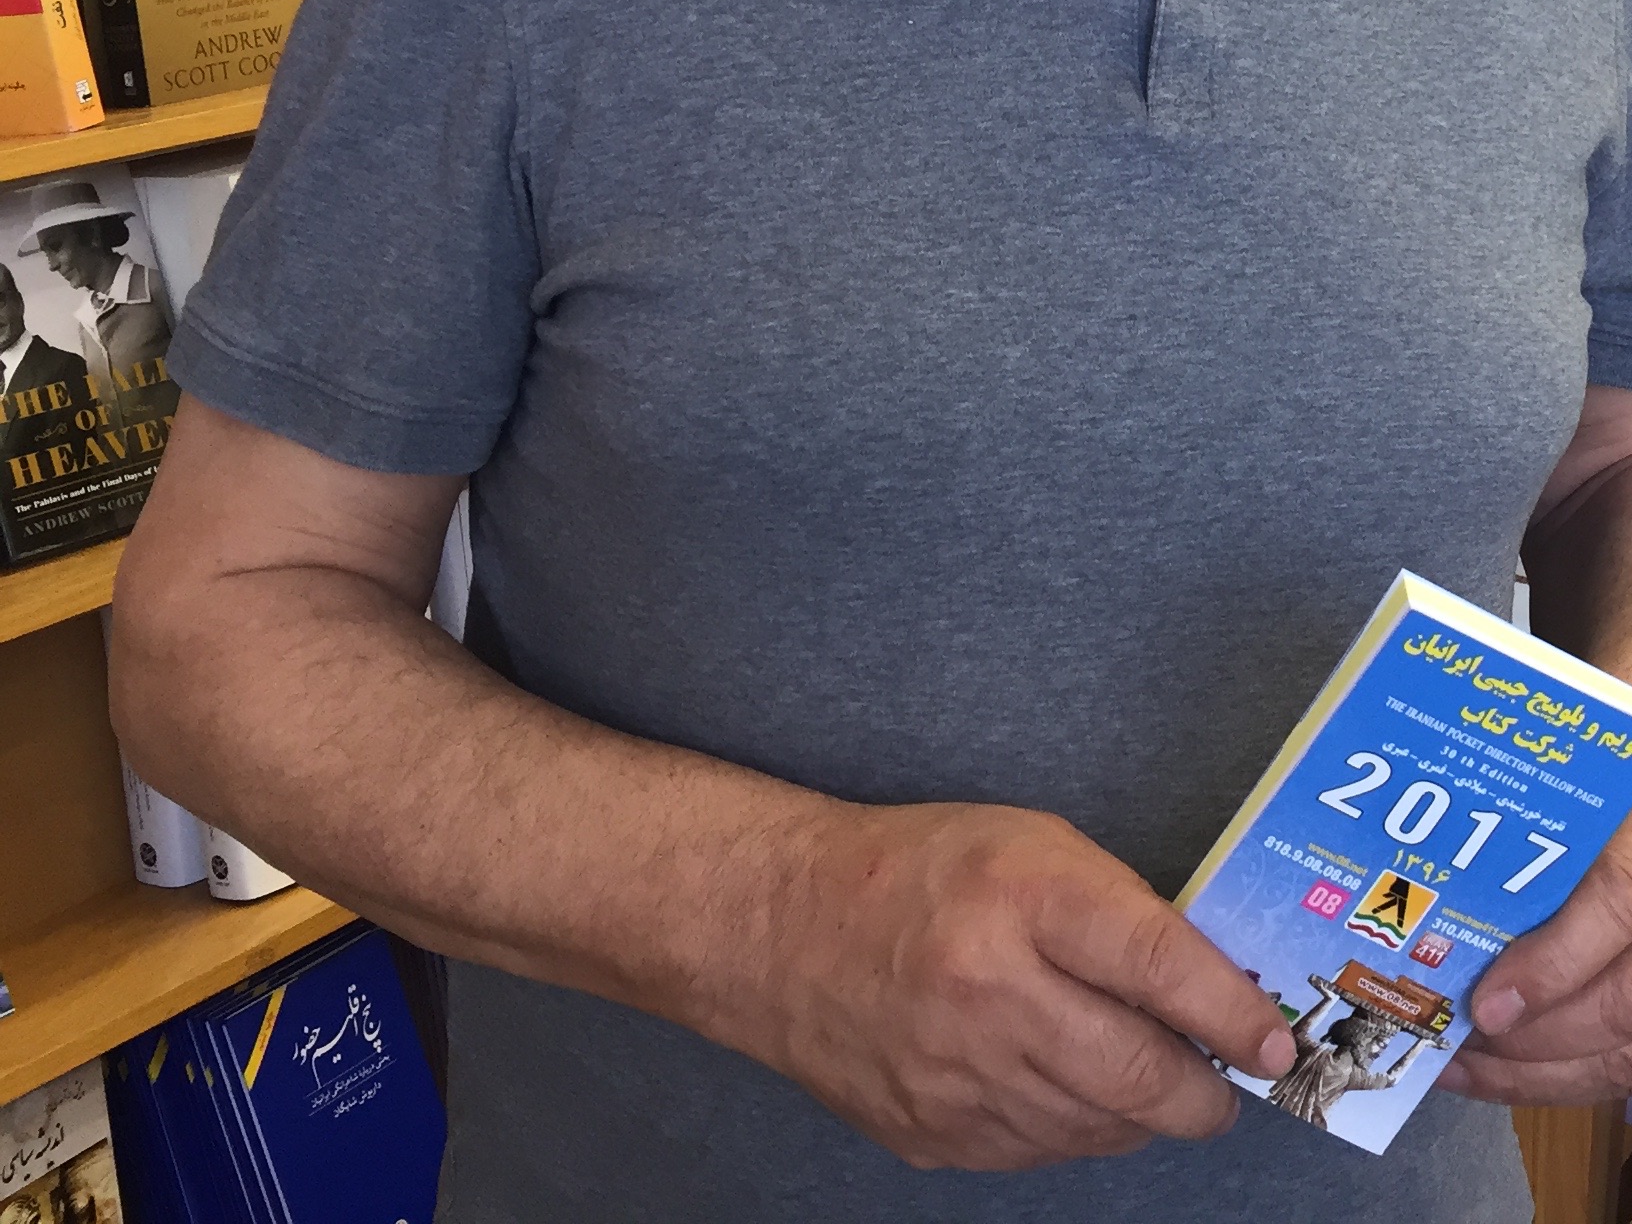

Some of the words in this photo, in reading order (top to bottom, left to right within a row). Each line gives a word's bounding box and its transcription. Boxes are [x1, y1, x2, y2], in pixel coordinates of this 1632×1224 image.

[175, 2, 212, 19] Changed
[224, 11, 252, 26] Middle
[252, 8, 271, 22] East
[193, 23, 283, 60] ANDREW
[162, 59, 231, 93] SCOTT
[74, 403, 114, 432] OF
[15, 501, 32, 514] The
[34, 493, 69, 509] Pahlavis
[69, 487, 86, 499] and
[86, 482, 101, 494] the
[101, 477, 123, 489] Final
[123, 470, 143, 484] Days
[143, 466, 153, 477] of
[22, 507, 93, 538] ANDREW
[97, 490, 146, 513] SCOTT
[1403, 633, 1485, 678] ایرانیان
[1471, 672, 1530, 704] جیبی
[1459, 705, 1519, 736] کتاب
[1579, 722, 1600, 742] و
[1385, 695, 1408, 714] THE
[1404, 703, 1448, 735] IRANIAN
[1448, 725, 1485, 753] POCKET
[1484, 742, 1538, 778] DIRECTORY
[1537, 767, 1575, 795] YELLOW
[1573, 787, 1606, 809] PAGES
[1513, 729, 1575, 765] شرکت
[1417, 758, 1448, 775] قمری
[1439, 744, 1458, 760] 30
[1460, 754, 1476, 769] th
[1478, 764, 1529, 794] Edition
[1453, 772, 1488, 796] میلادی
[1317, 749, 1570, 895] 2017
[1495, 793, 1542, 821] خورشیدی
[1262, 835, 1363, 892] 818.9.08.08.08
[1392, 848, 1451, 885] ۱۳۹۶
[1306, 886, 1344, 915] 08
[1414, 944, 1446, 965] 411
[1357, 976, 1423, 1016] www.08.net
[361, 993, 382, 1054] پنج
[292, 1025, 321, 1066] حضور
[333, 1096, 359, 1118] شایگان
[358, 1081, 382, 1105] داریوش
